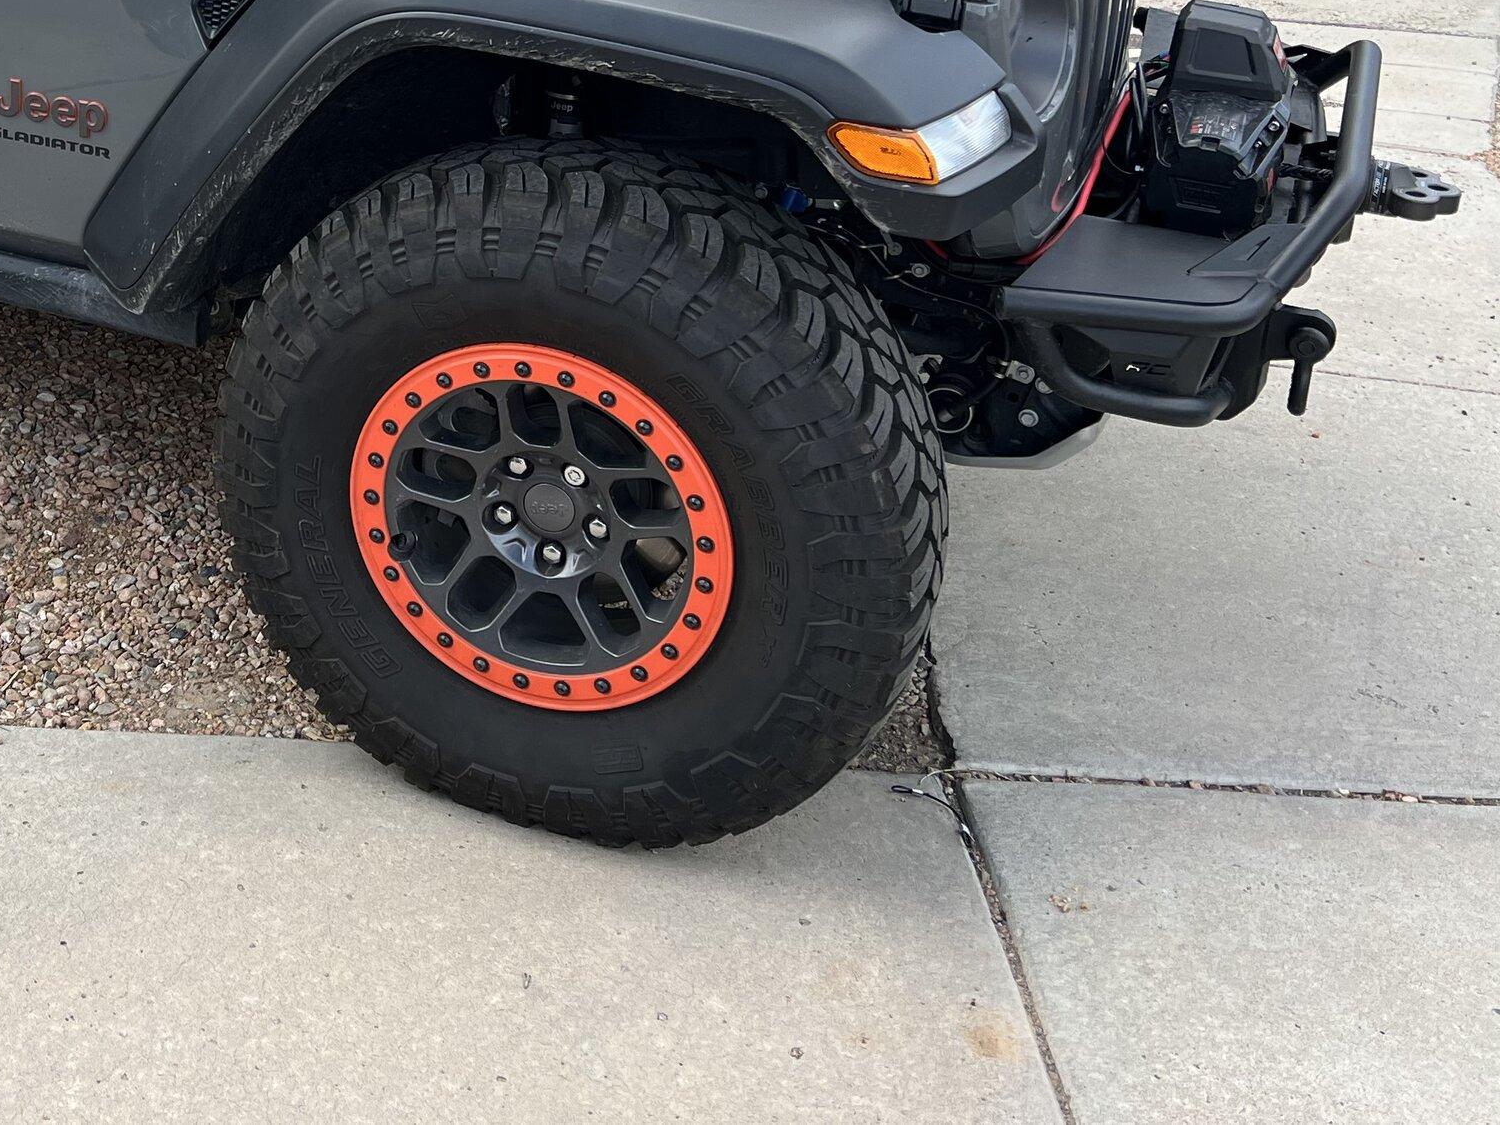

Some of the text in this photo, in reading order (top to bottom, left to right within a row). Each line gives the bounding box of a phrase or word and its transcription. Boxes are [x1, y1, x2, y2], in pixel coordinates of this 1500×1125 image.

[551, 100, 574, 113] Jeep
[293, 454, 402, 679] GENERAL
[665, 372, 789, 627] GRABBER
